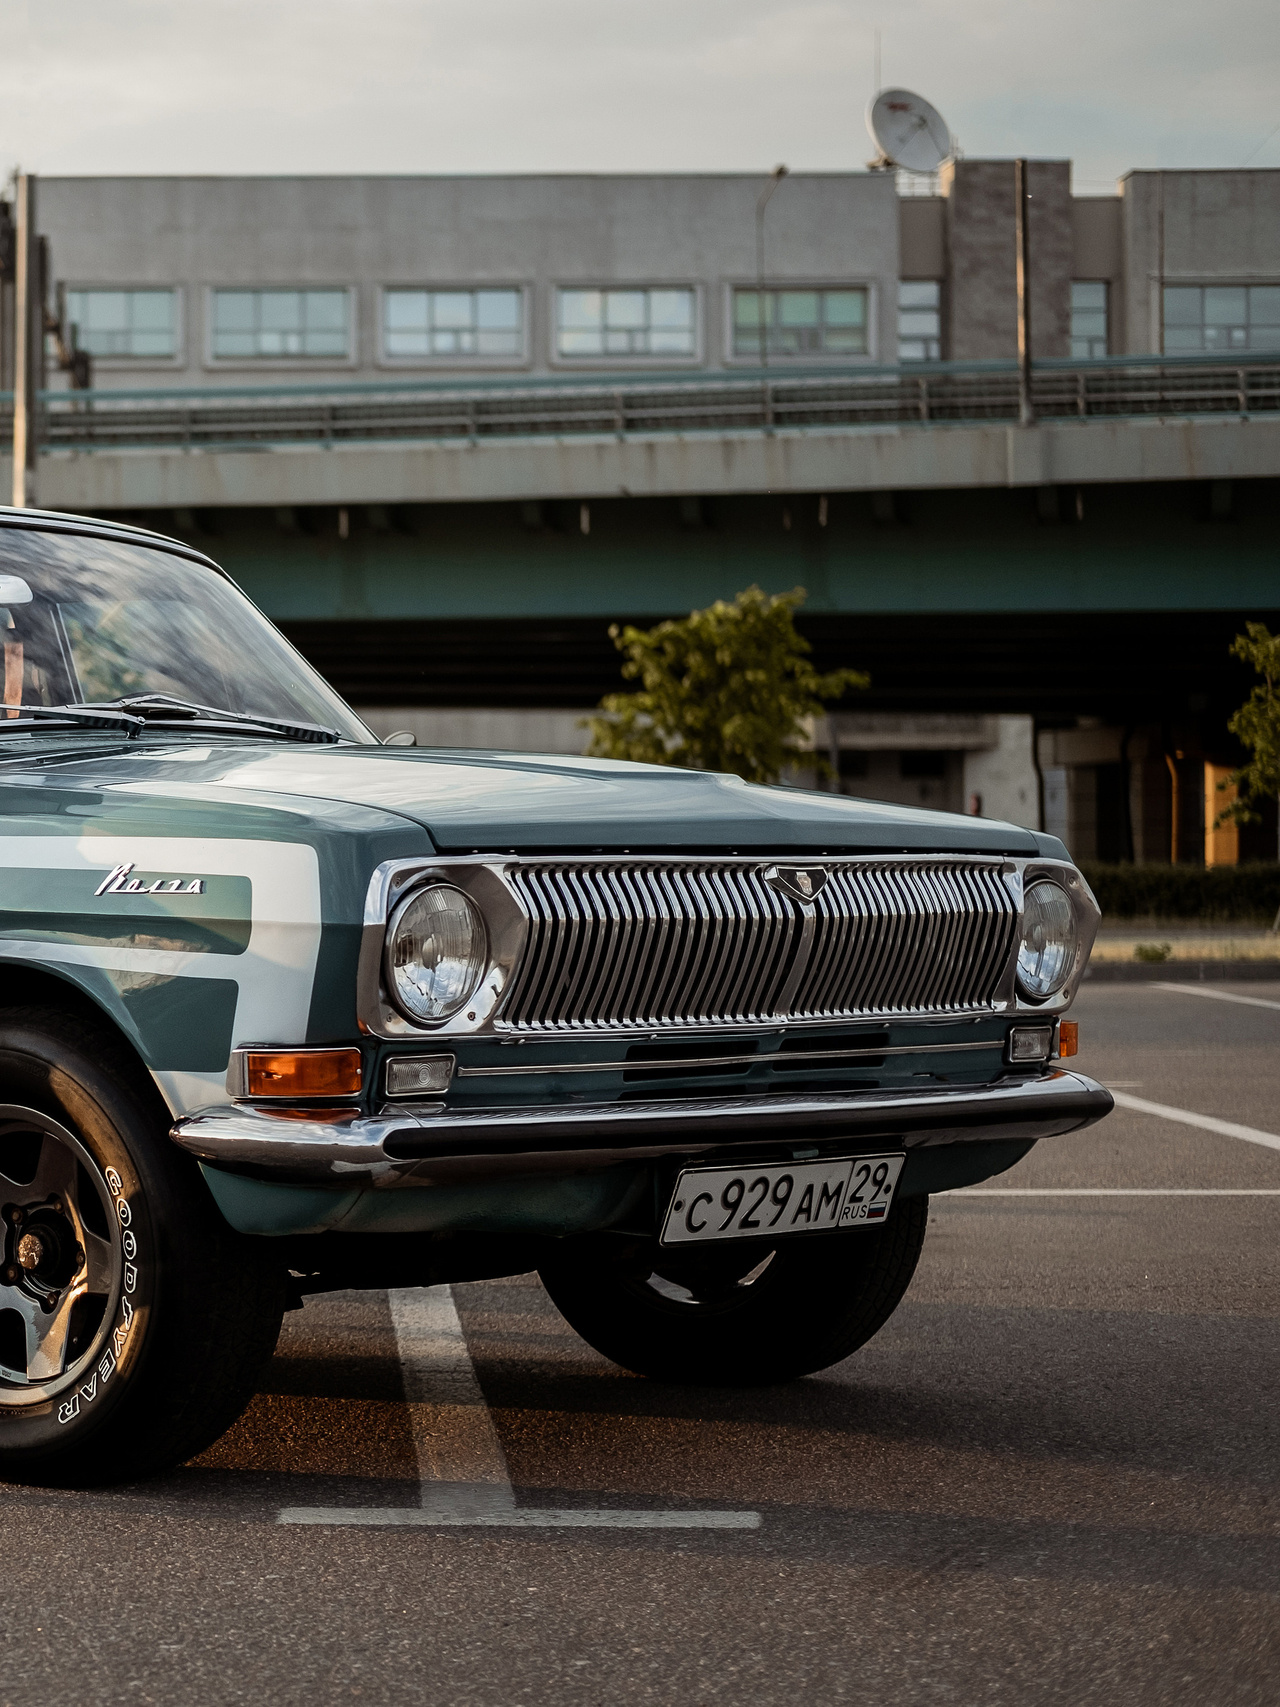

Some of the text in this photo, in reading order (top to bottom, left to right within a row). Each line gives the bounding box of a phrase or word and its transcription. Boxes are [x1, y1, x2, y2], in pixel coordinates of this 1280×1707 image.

[849, 1162, 889, 1203] 29
[841, 1204, 868, 1220] RUS
[58, 1165, 138, 1425] GOODYEAR
